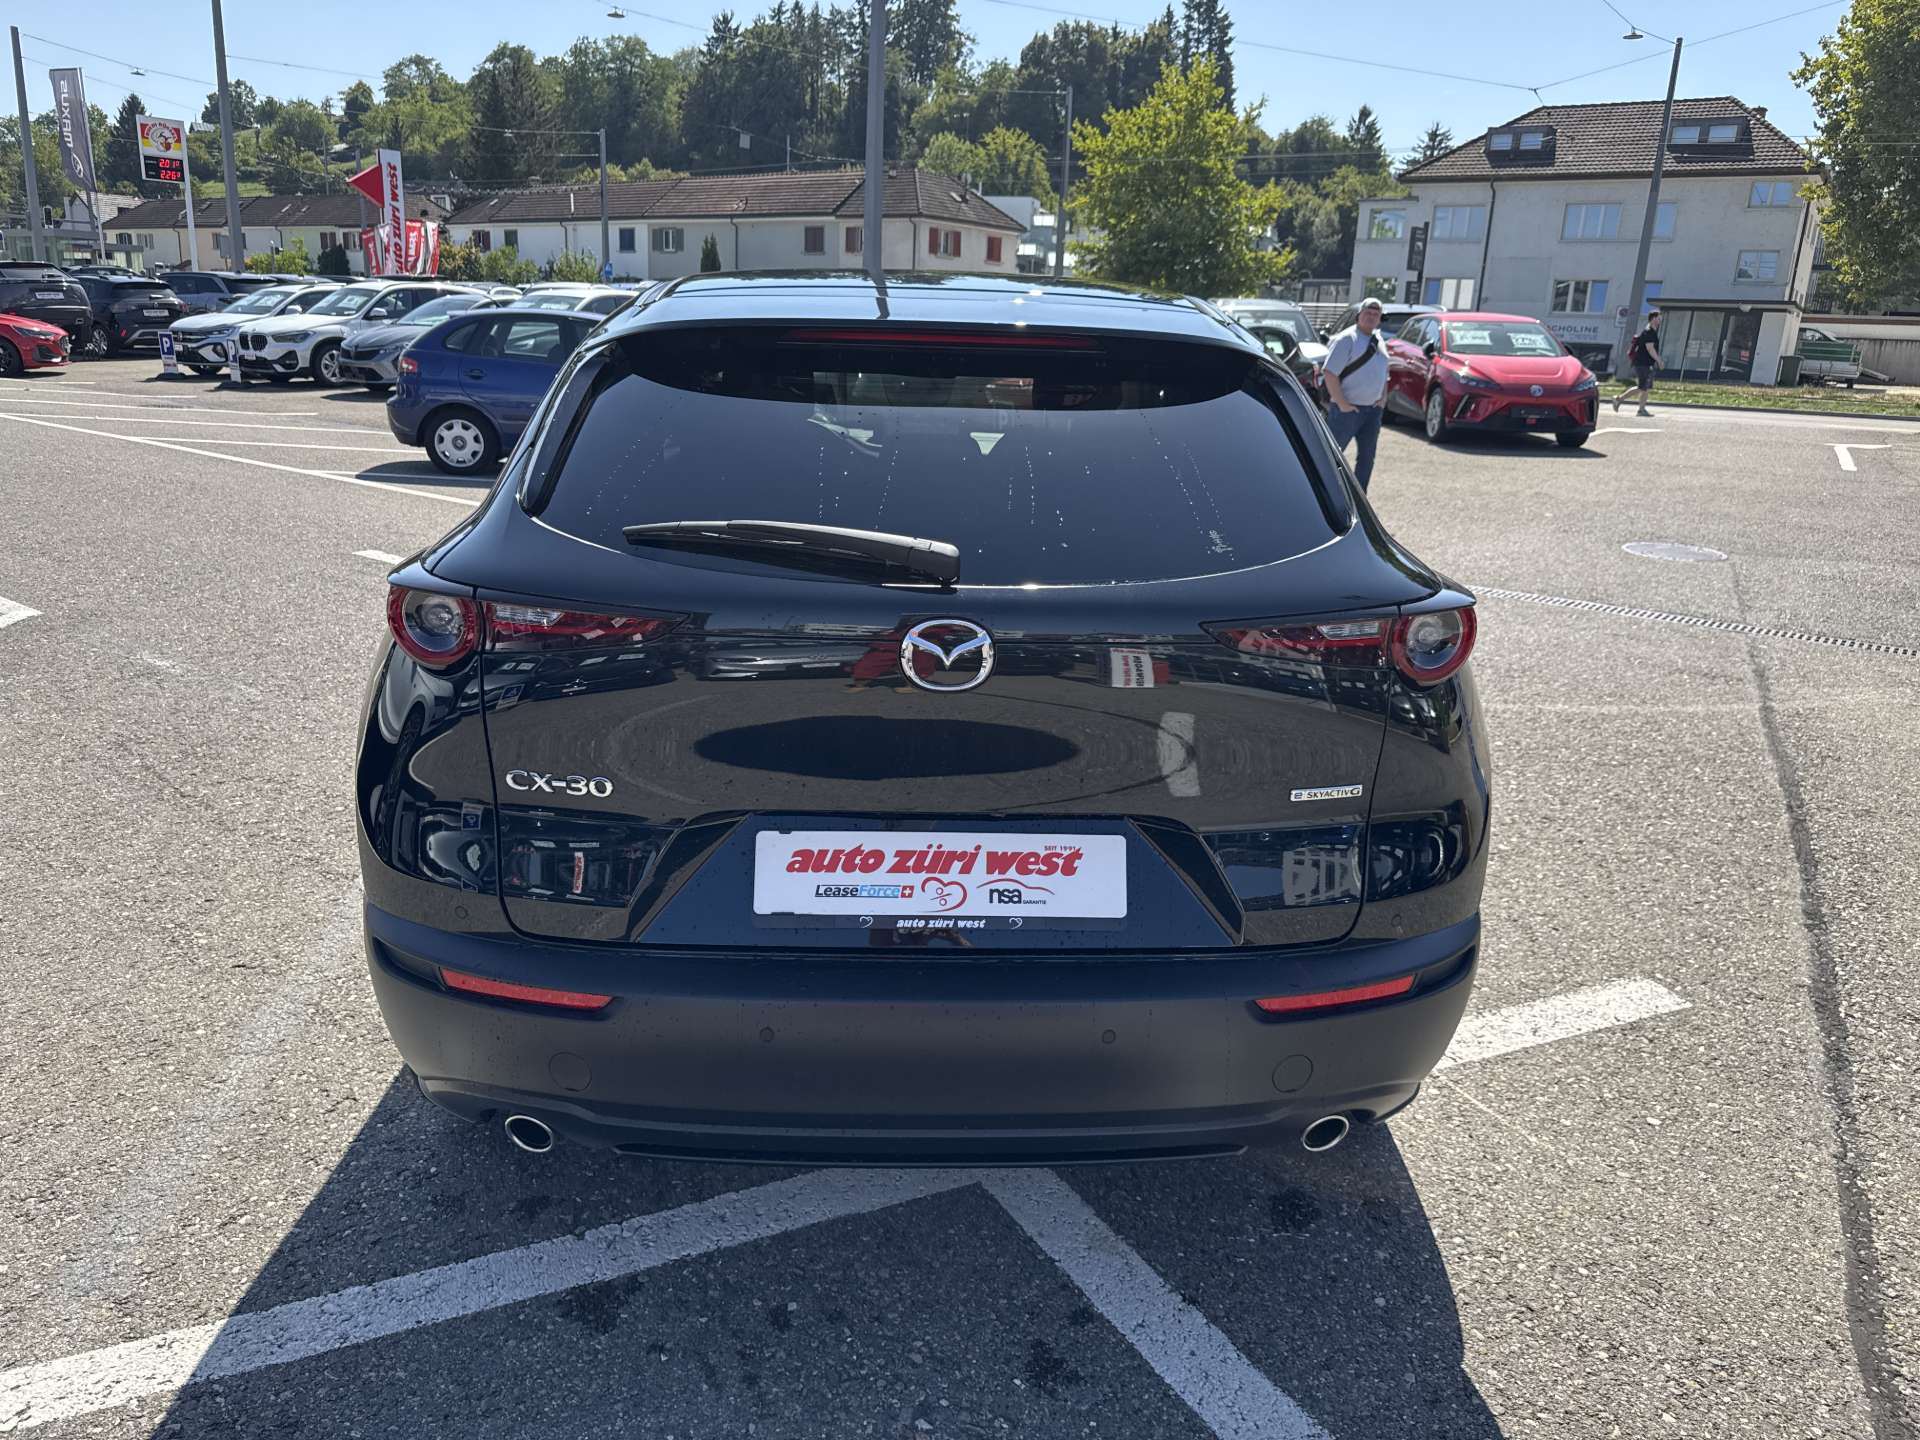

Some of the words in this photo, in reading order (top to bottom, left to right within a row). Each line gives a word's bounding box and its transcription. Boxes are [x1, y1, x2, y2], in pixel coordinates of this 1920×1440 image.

[387, 162, 399, 202] west
[1548, 324, 1600, 334] CHOLINE
[162, 337, 170, 352] P
[505, 769, 614, 798] CX-30
[786, 843, 886, 874] auto
[886, 843, 982, 875] züri
[986, 846, 1083, 877] west
[815, 884, 900, 897] LeaseForce
[989, 888, 1022, 904] nsa
[896, 918, 926, 928] auto
[927, 918, 955, 928] züri
[957, 918, 986, 929] west
